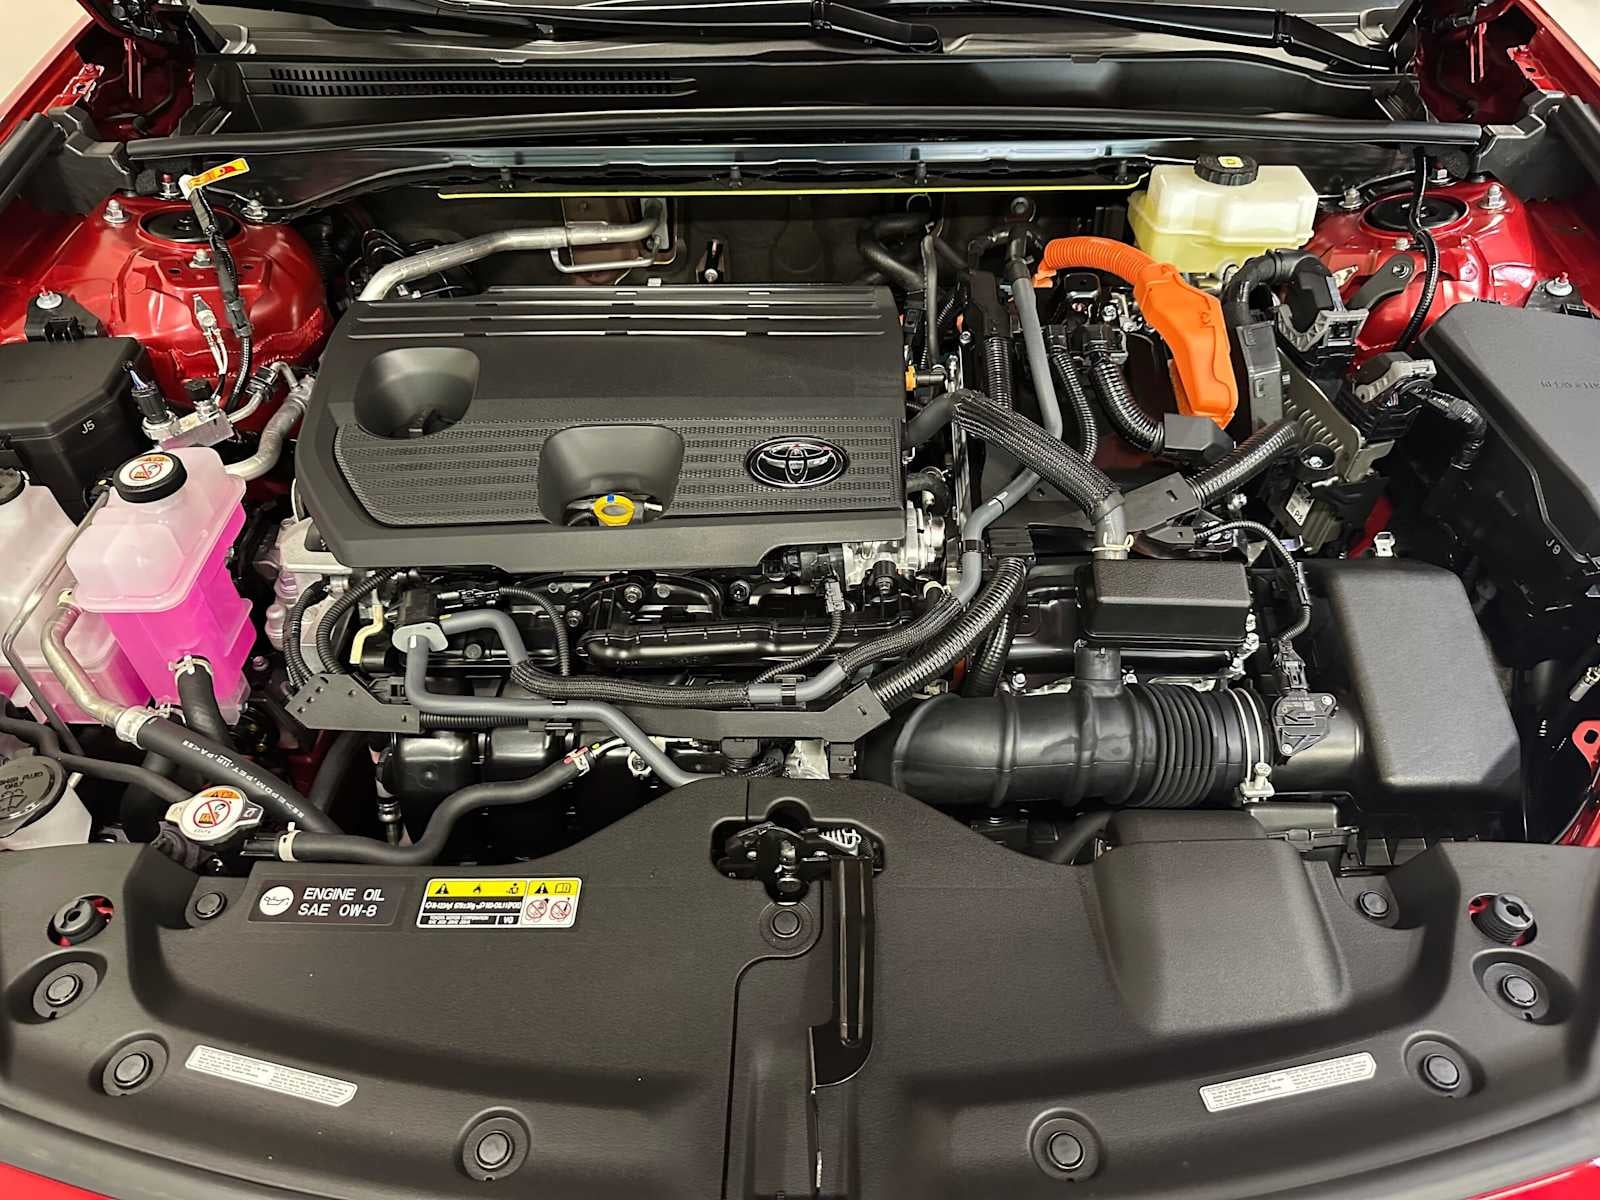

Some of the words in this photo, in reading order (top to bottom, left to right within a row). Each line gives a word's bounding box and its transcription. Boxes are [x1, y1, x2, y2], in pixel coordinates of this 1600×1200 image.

[81, 420, 95, 434] J5
[1545, 538, 1561, 555] J9
[302, 887, 357, 901] ENGINE
[363, 889, 385, 902] OIL
[298, 903, 331, 917] SAE
